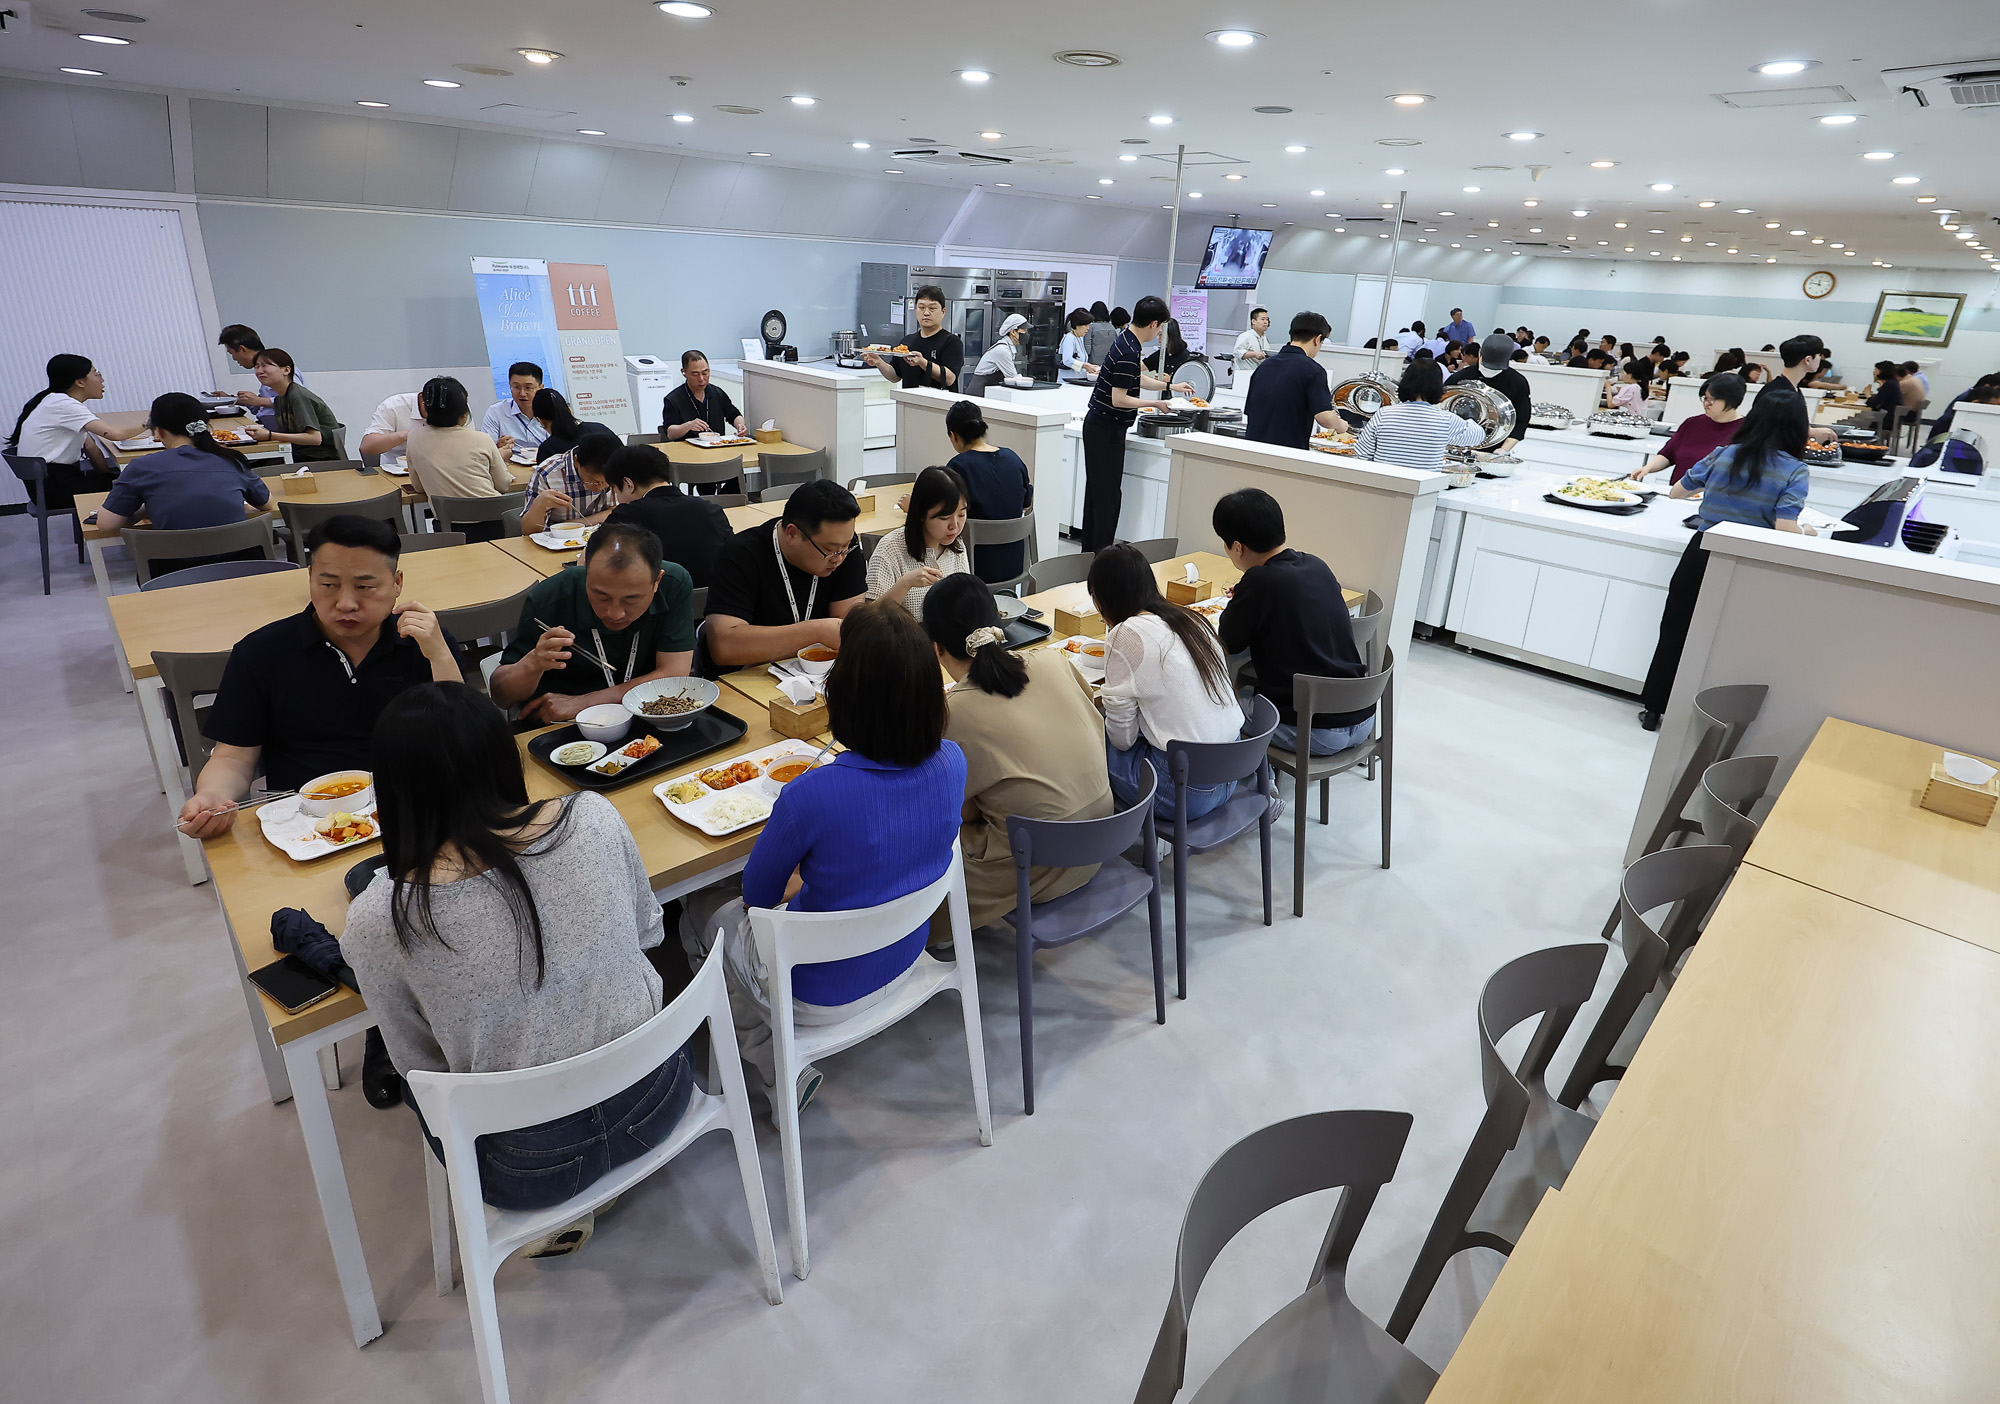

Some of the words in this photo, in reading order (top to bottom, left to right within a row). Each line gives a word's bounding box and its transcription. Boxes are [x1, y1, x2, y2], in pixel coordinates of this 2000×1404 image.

[500, 287, 532, 301] Alice
[570, 308, 601, 317] COFFEE
[500, 318, 541, 331] Brown
[564, 335, 593, 346] GRAND
[595, 335, 617, 345] OPEN
